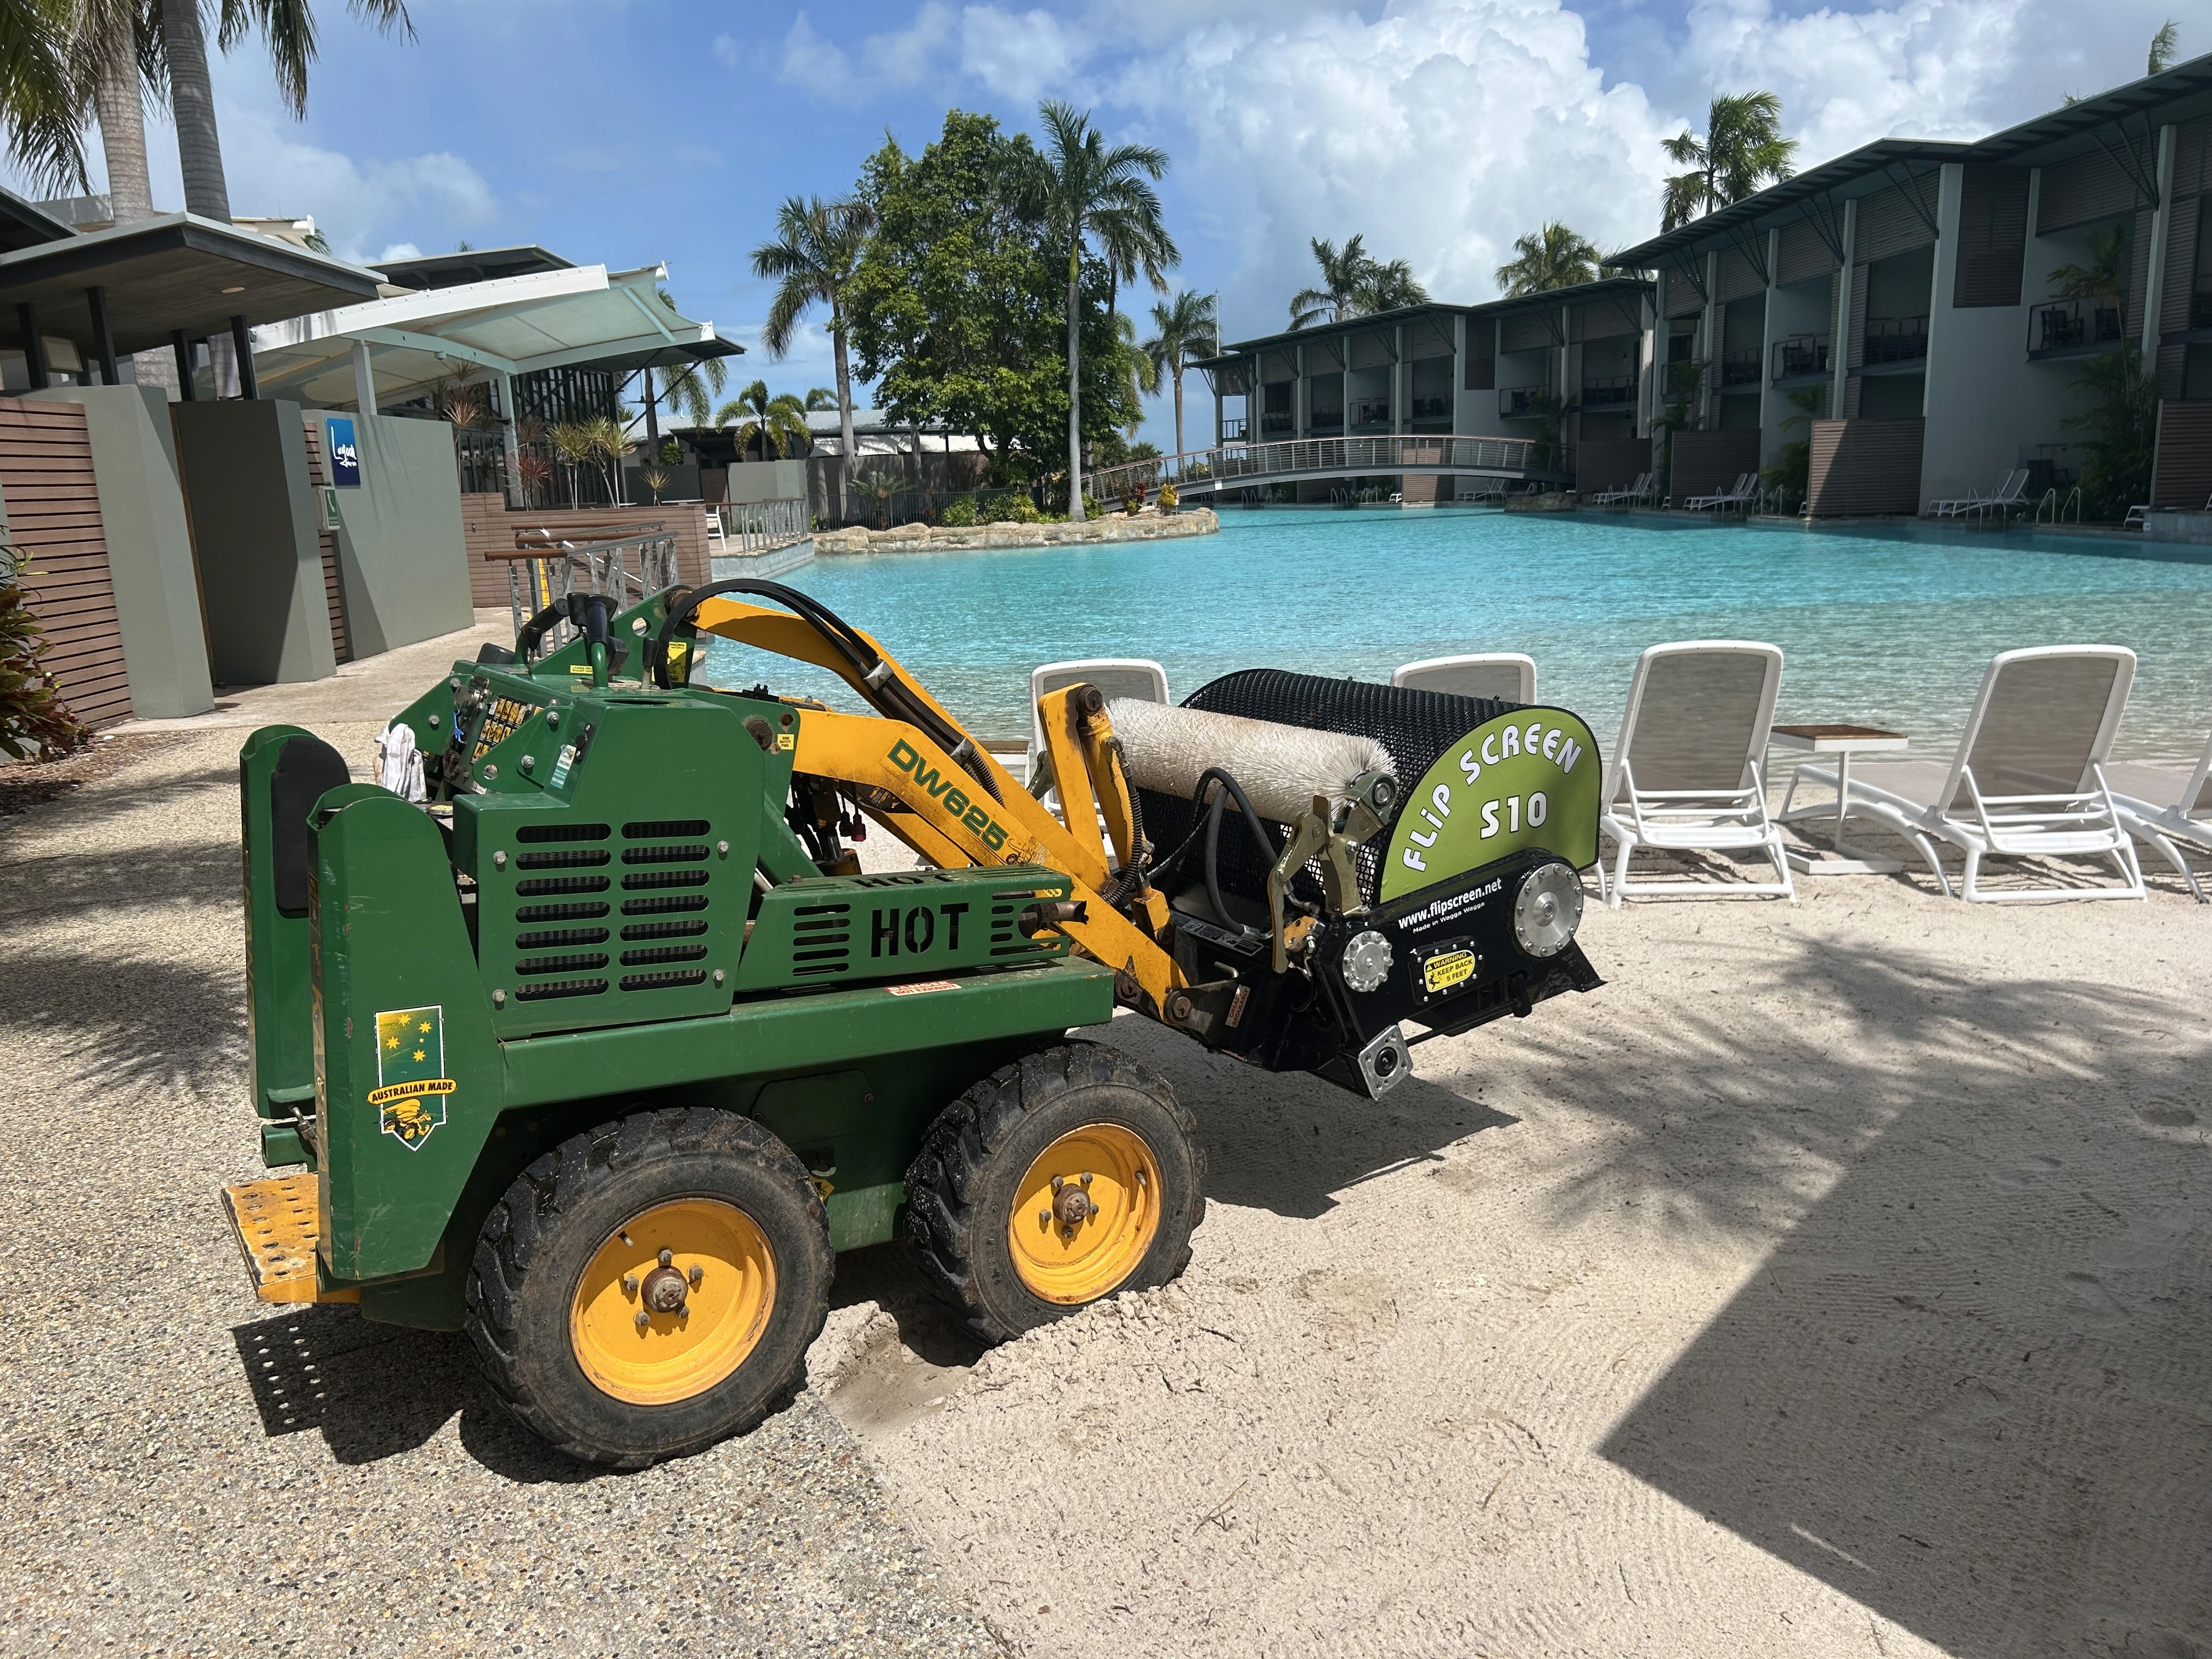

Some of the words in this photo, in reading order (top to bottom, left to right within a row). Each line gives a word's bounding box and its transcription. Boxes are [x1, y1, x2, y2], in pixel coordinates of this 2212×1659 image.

[1459, 722, 1583, 786] SCREEN
[886, 738, 1009, 851] DW625
[1480, 791, 1548, 840] S10
[1398, 877, 1502, 929] www.flipscreen.net
[1413, 923, 1431, 934] Made
[1440, 911, 1462, 923] Wagga
[1463, 901, 1485, 913] Wagga
[871, 902, 969, 958] HOT
[1433, 951, 1467, 968] WARNING
[1437, 966, 1453, 977] KEEP
[1455, 958, 1472, 970] BACK
[1452, 969, 1468, 979] FEET
[372, 1083, 425, 1103] AUSTRALIAN
[428, 1081, 453, 1091] MADE
